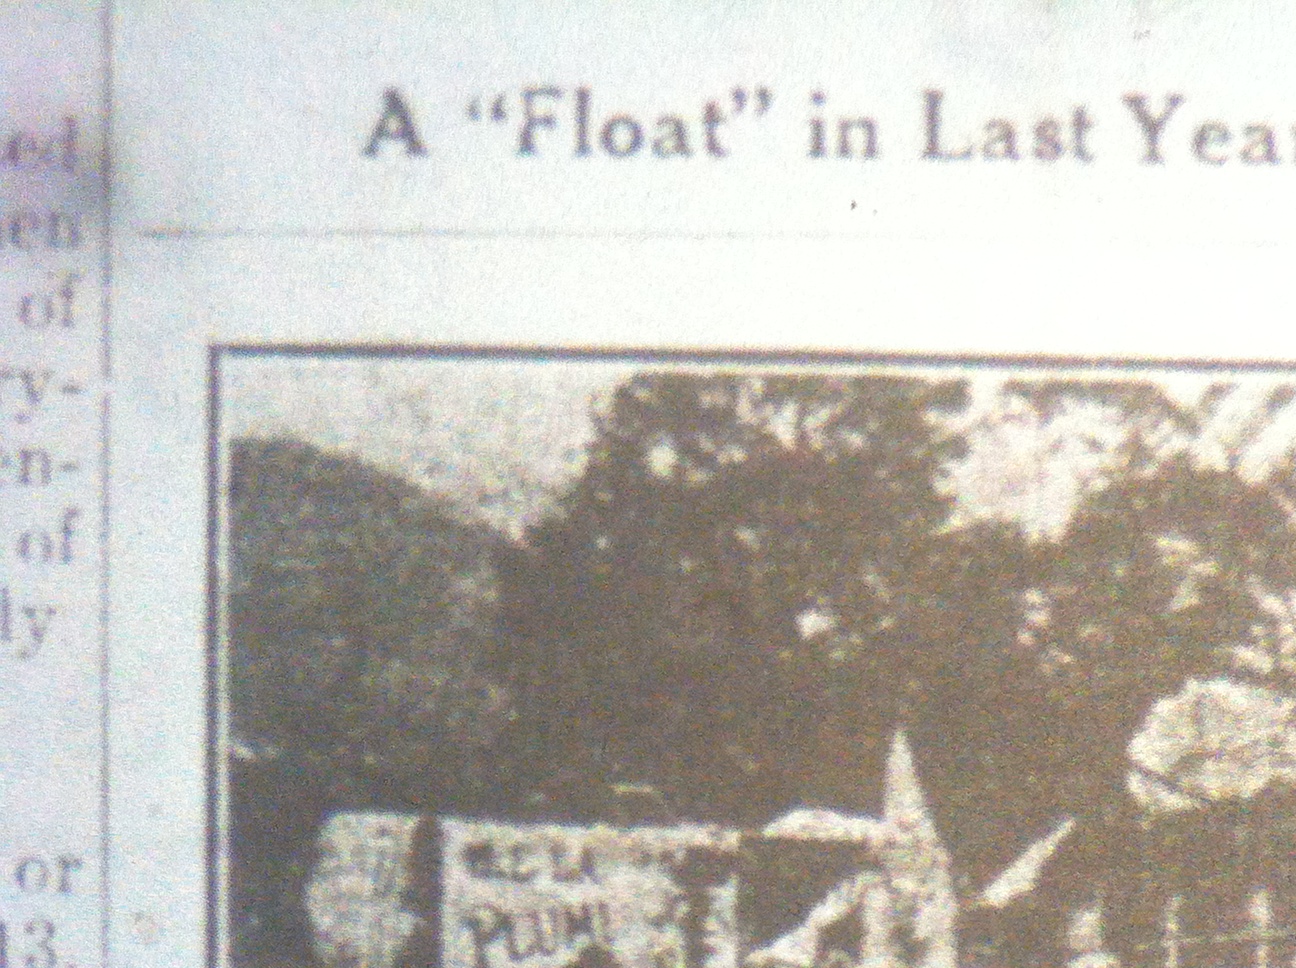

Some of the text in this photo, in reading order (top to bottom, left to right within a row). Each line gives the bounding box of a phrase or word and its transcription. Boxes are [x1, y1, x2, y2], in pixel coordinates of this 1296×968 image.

[362, 86, 429, 159] A
[808, 90, 880, 160] in
[920, 88, 1095, 163] Last
[13, 854, 84, 897] or
